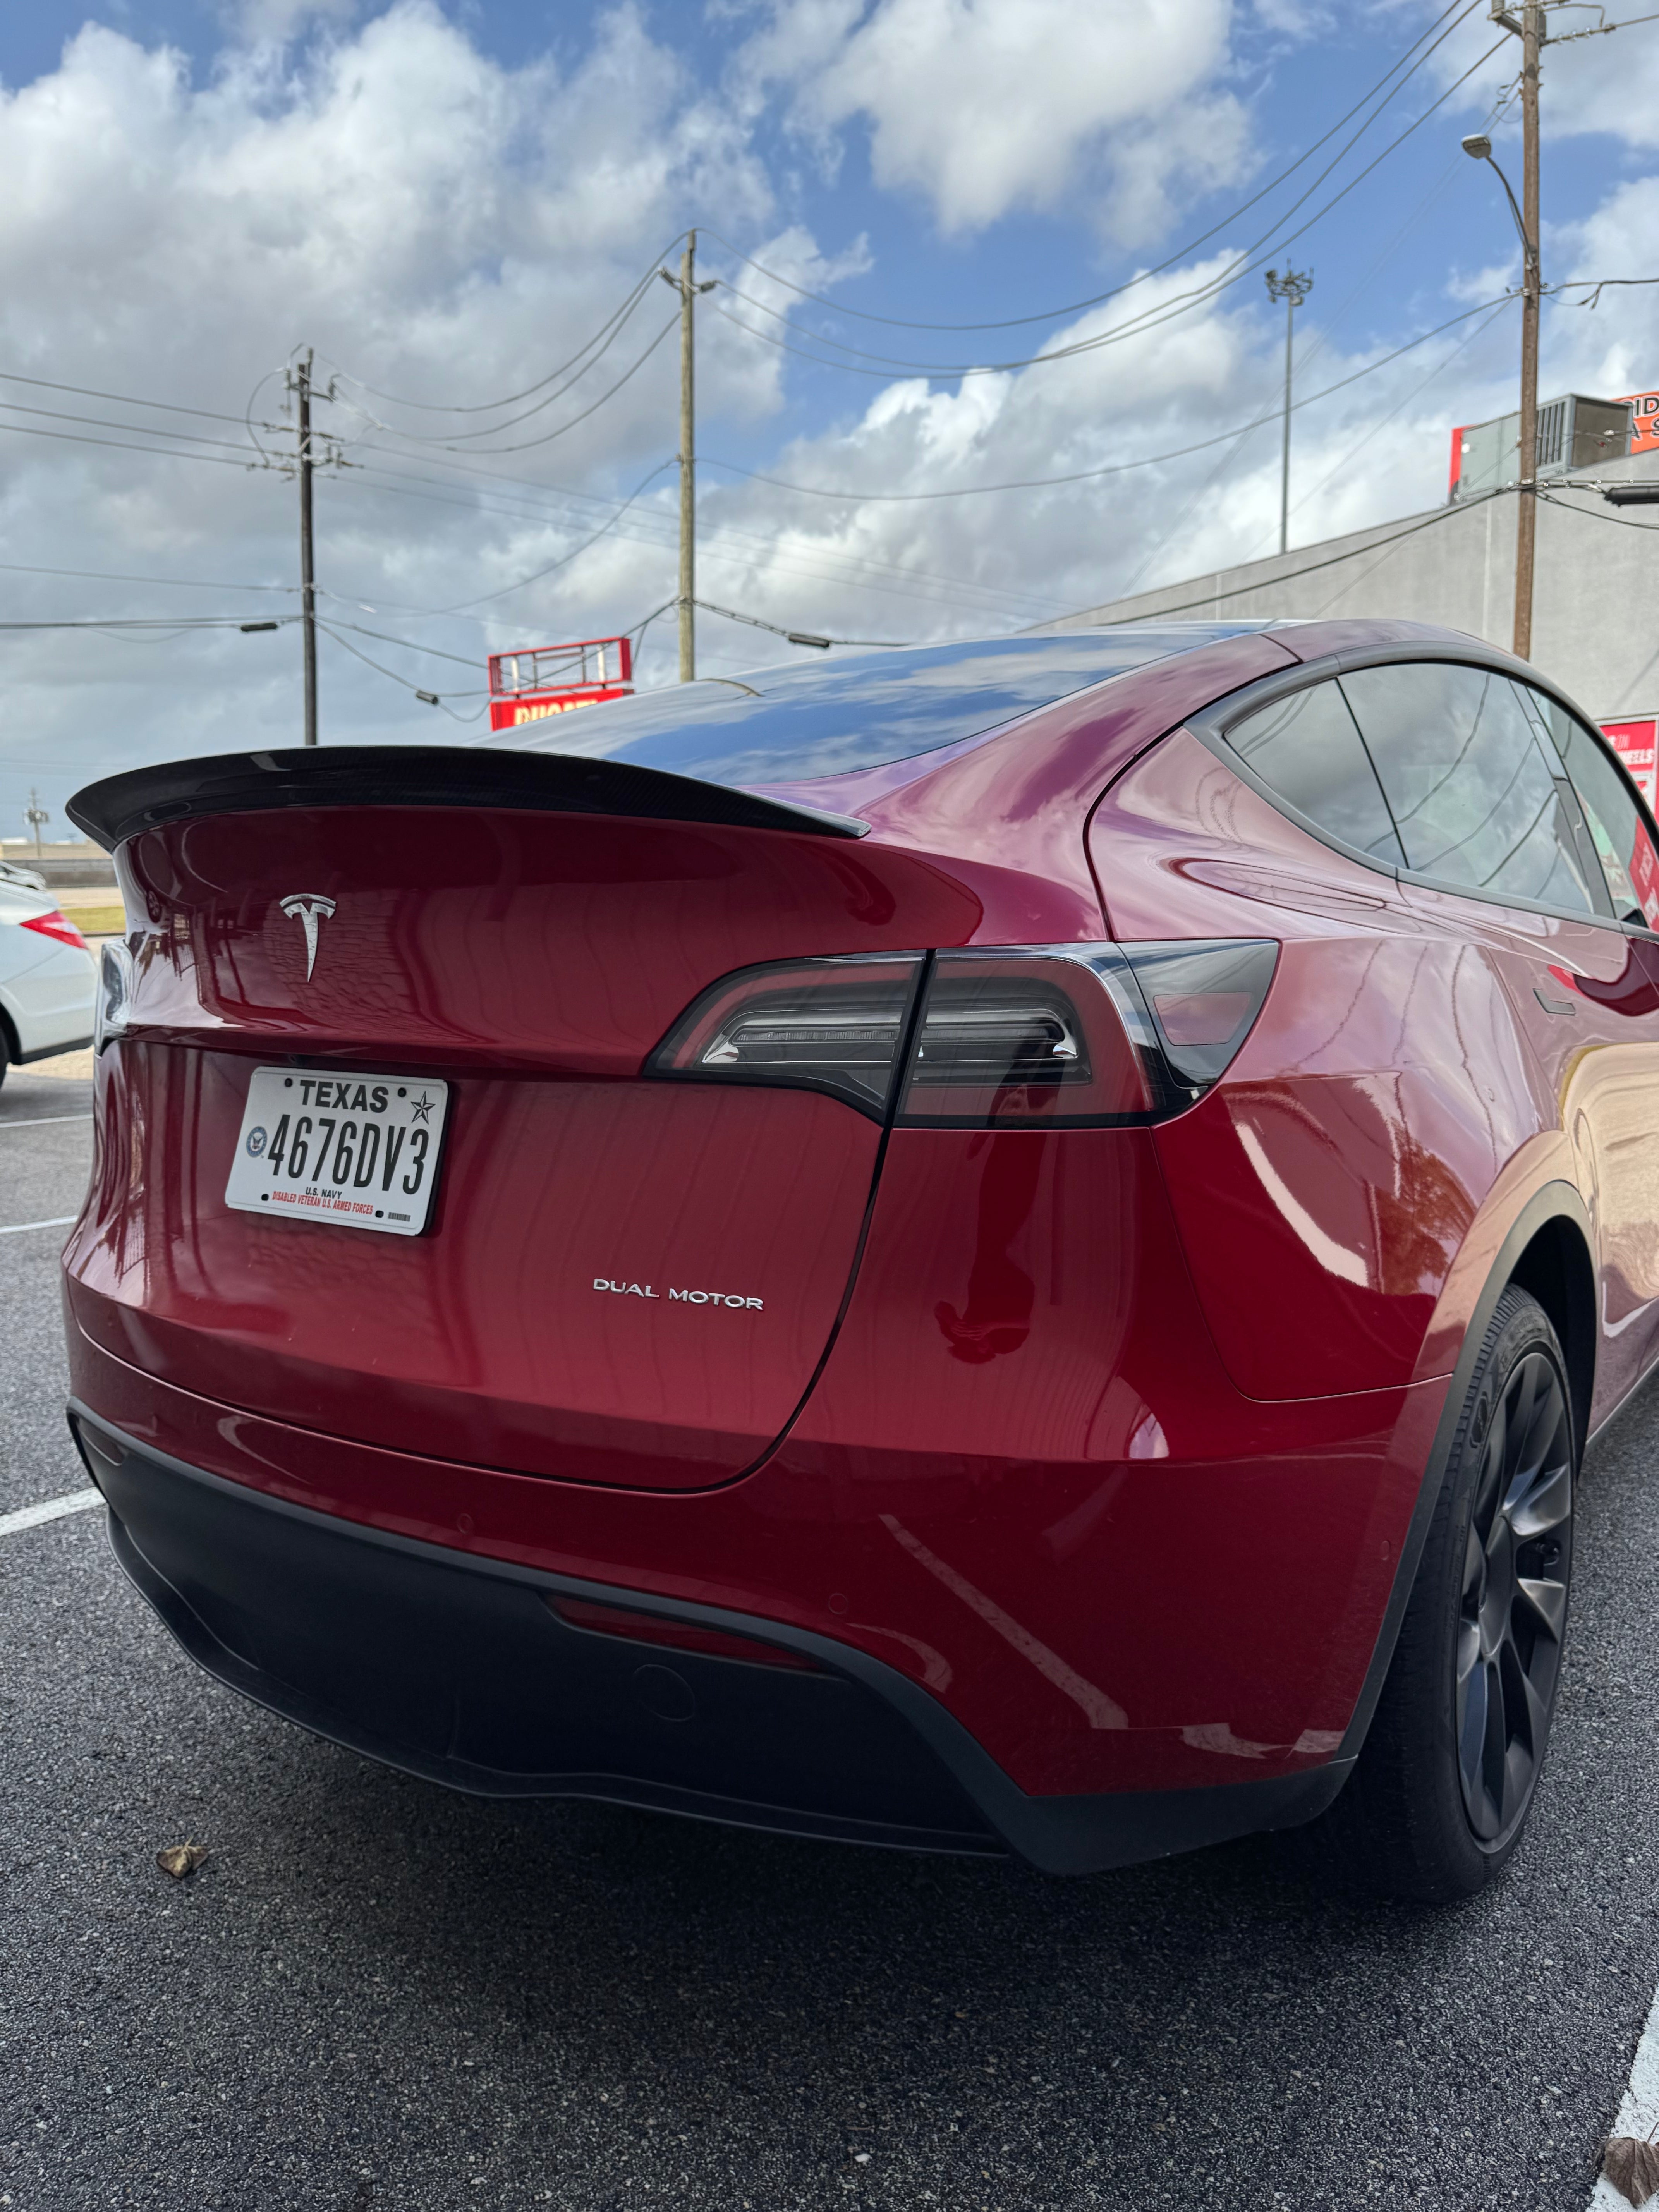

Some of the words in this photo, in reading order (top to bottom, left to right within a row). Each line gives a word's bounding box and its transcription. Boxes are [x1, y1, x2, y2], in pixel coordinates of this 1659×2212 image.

[300, 1080, 389, 1113] TEXAS
[268, 1114, 429, 1195] 4676DV3
[272, 1191, 296, 1203] DISABLED
[297, 1194, 321, 1207] VETERAN
[322, 1198, 331, 1209] U.S.
[333, 1200, 352, 1211] ARMED
[352, 1202, 373, 1215] FORCES
[306, 1187, 318, 1196] U.S.
[321, 1189, 342, 1199] NAVY
[593, 1278, 660, 1297] DUAL
[668, 1288, 764, 1310] MOTOR
